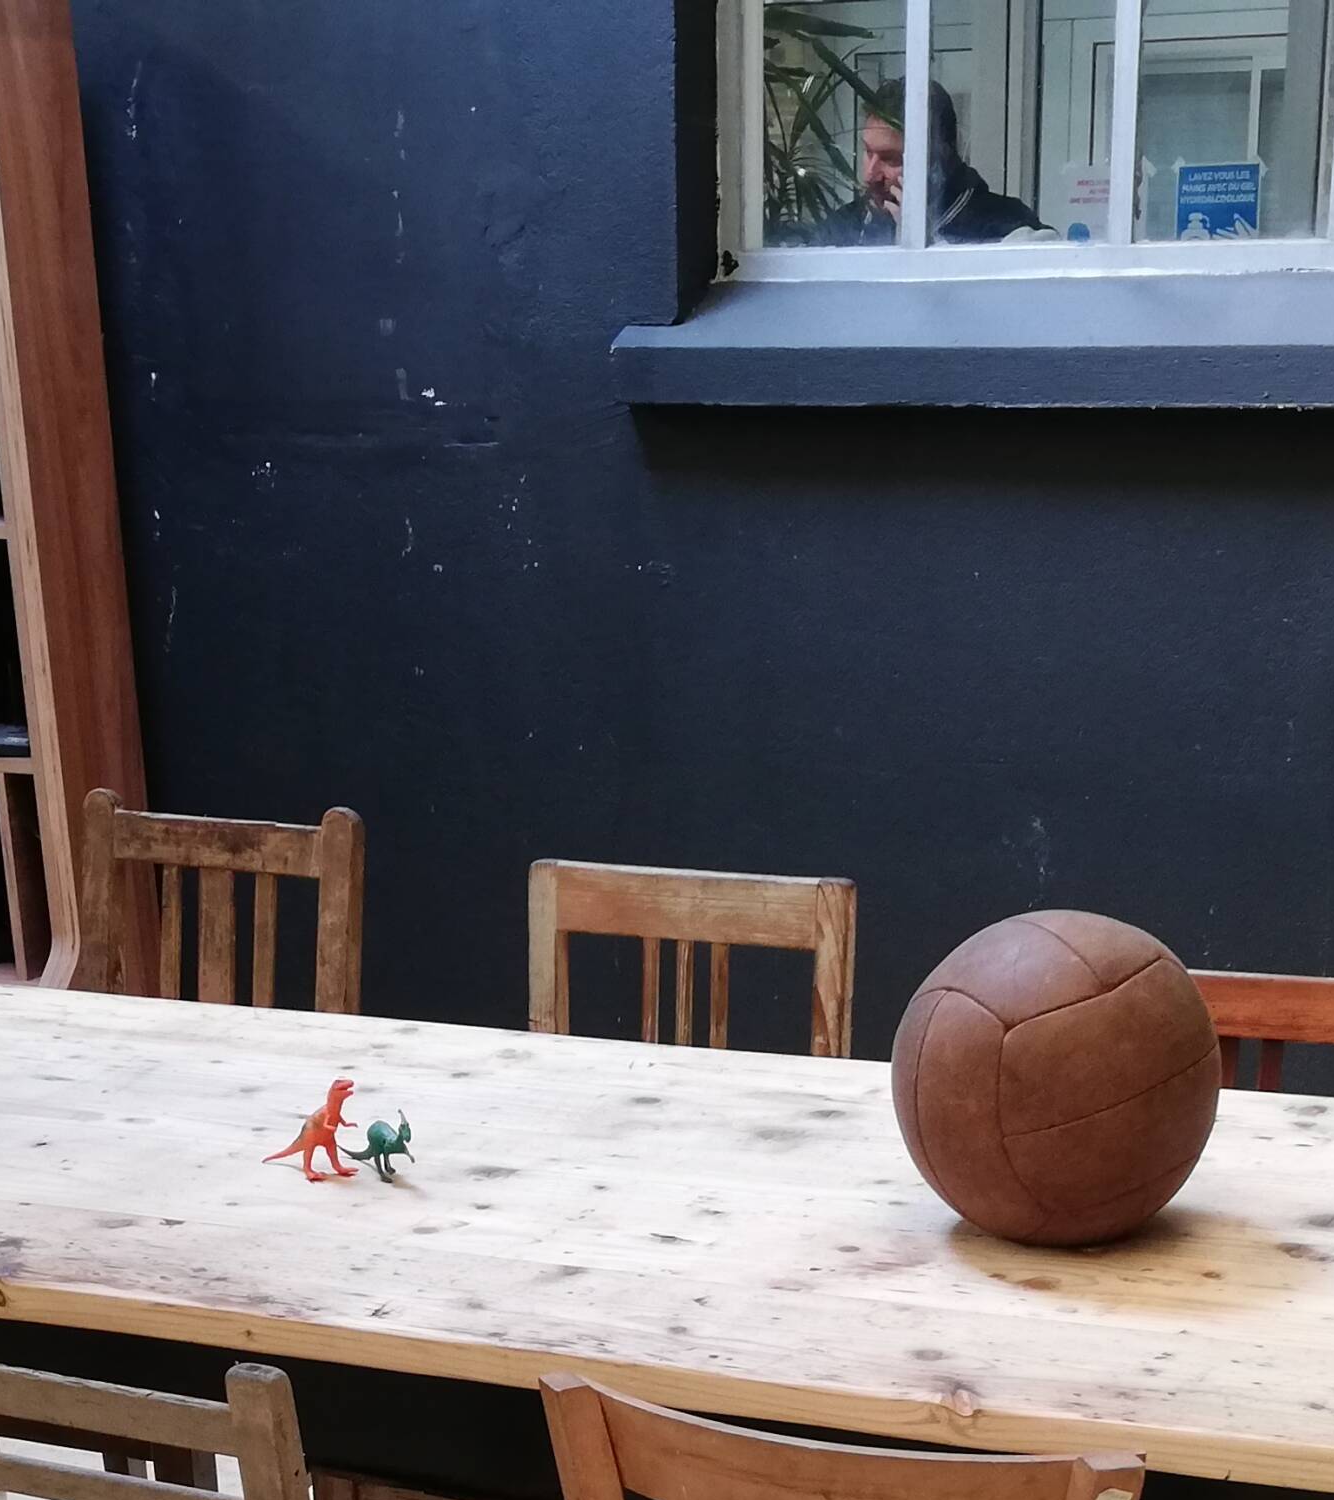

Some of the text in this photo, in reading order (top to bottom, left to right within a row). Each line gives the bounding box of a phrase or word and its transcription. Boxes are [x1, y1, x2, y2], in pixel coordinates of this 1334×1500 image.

[1188, 169, 1250, 182] LAVEZ VOUS LES
[1181, 181, 1256, 193] MAINS AVEC DU GEL
